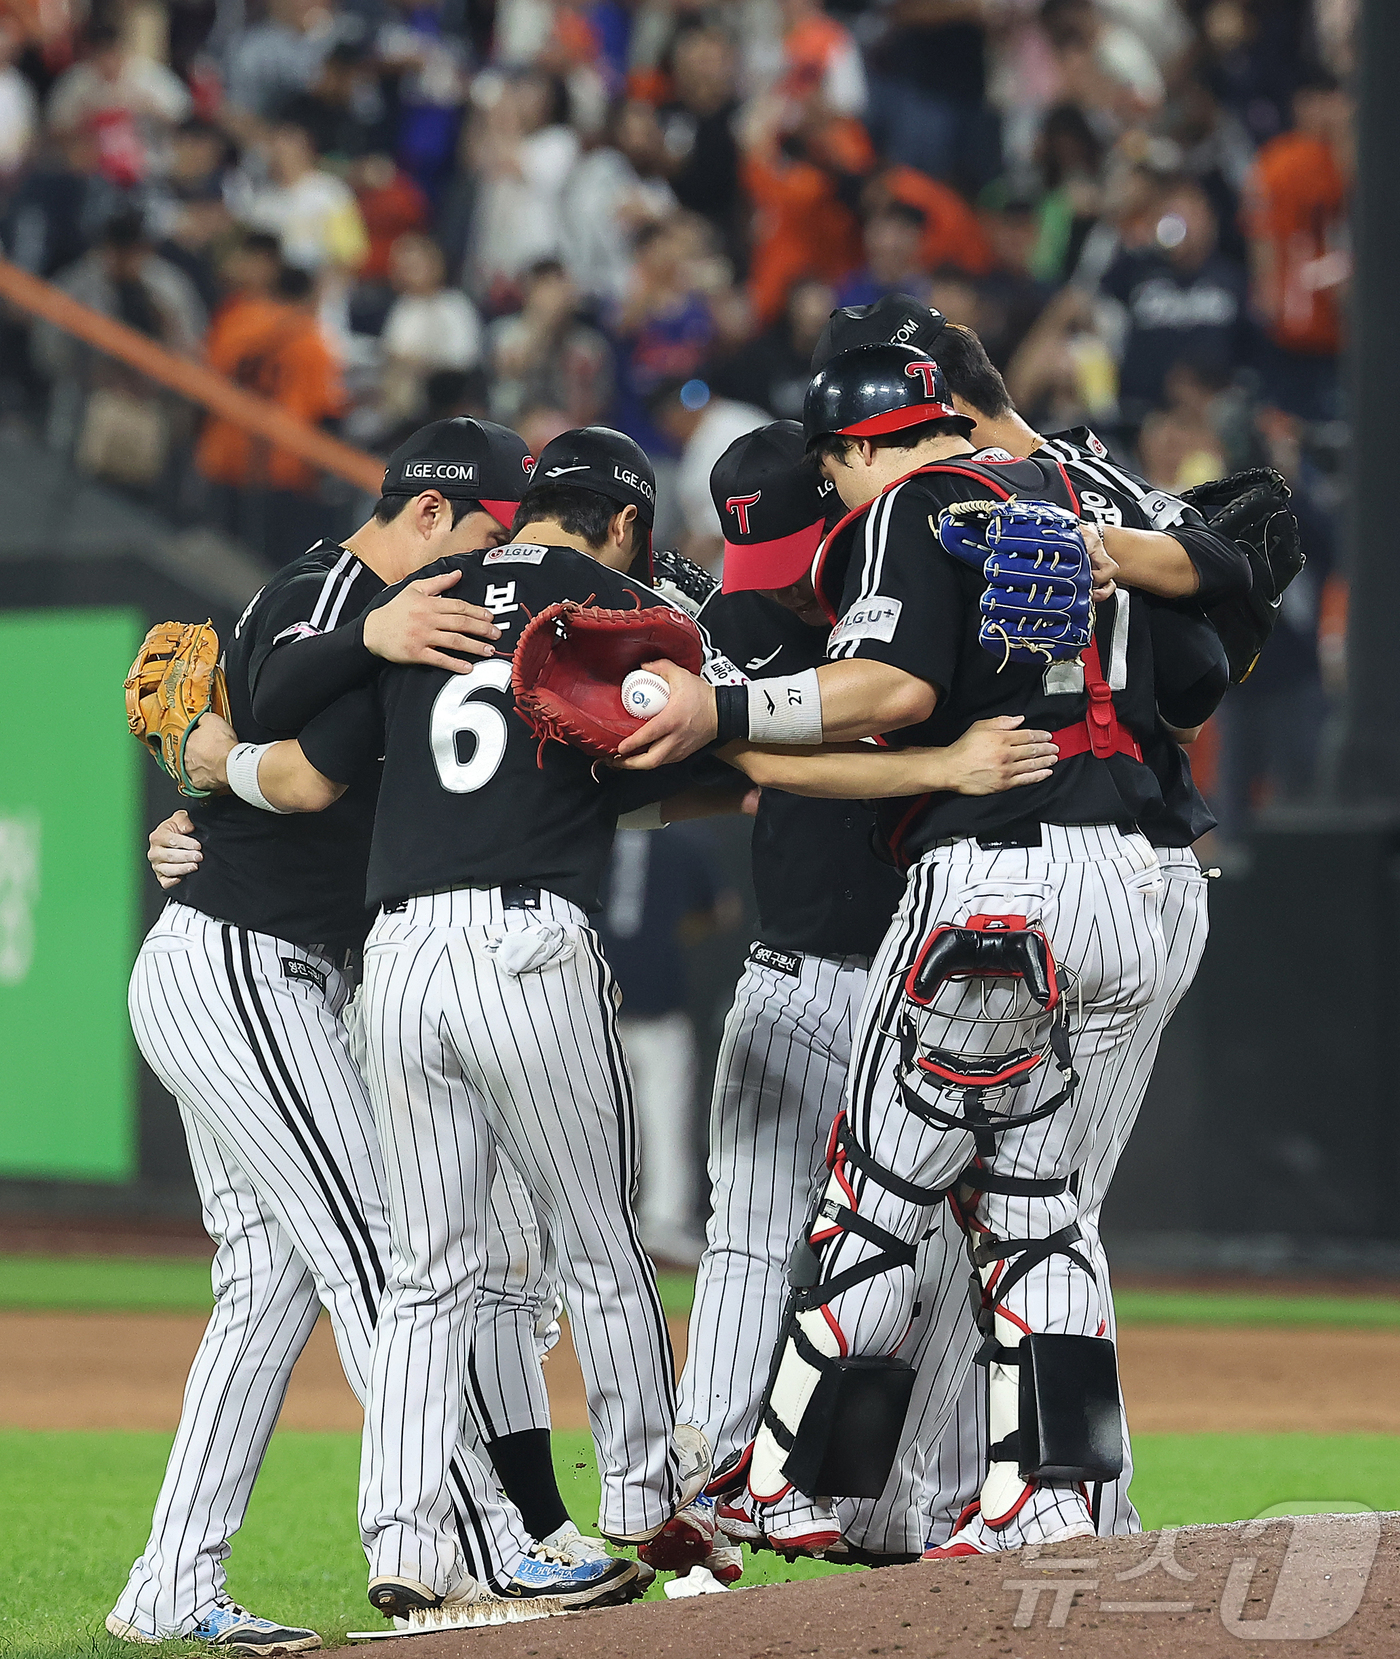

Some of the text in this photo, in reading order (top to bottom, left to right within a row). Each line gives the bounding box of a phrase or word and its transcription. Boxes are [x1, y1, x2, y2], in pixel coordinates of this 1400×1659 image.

[405, 464, 474, 481] LGE.COM
[787, 687, 803, 706] 27
[429, 658, 513, 794] 6
[755, 947, 798, 972] 영진구론산
